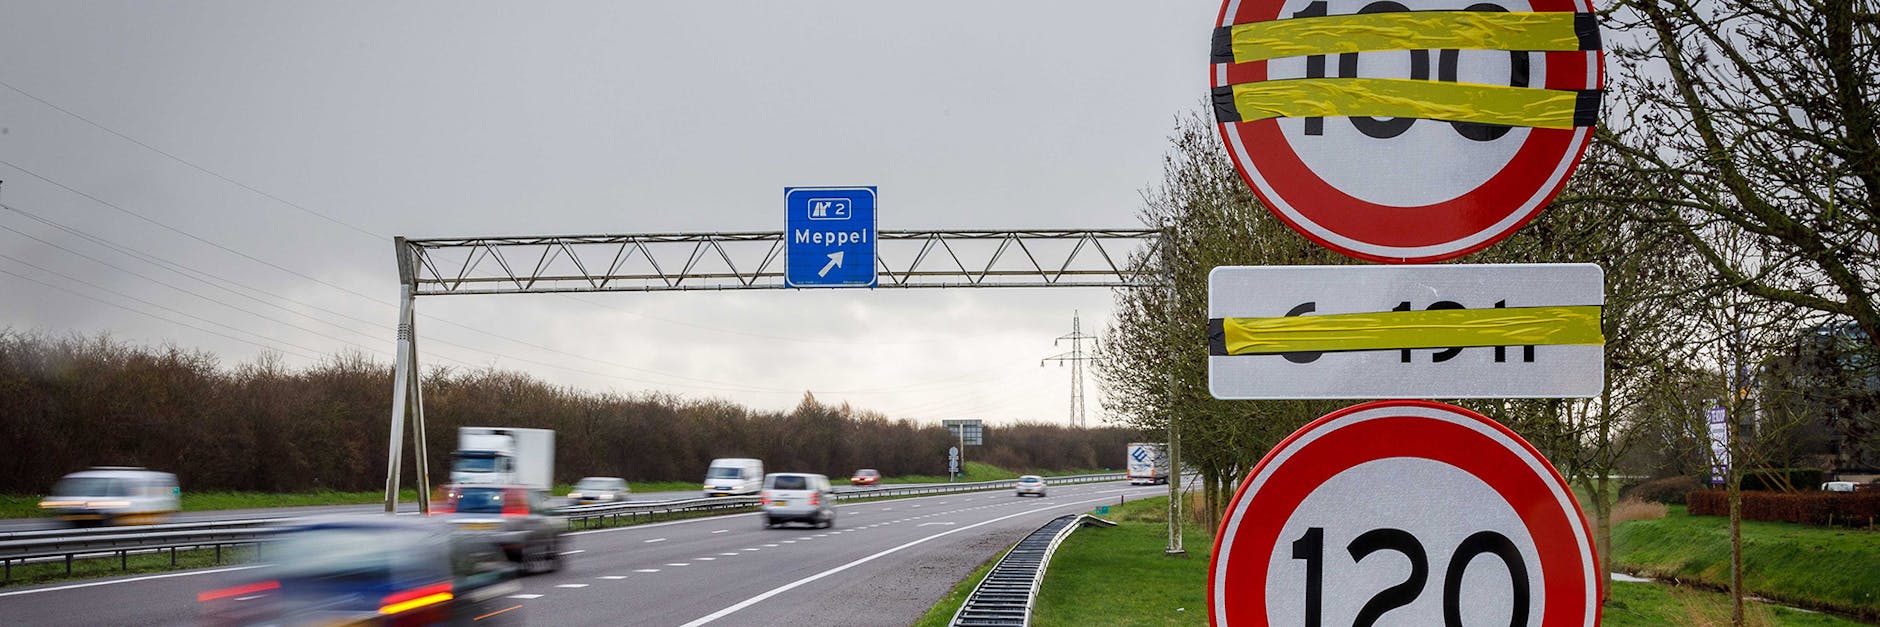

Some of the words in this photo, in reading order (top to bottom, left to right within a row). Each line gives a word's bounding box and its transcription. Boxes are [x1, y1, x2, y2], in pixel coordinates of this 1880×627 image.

[835, 203, 845, 215] 2
[795, 228, 867, 246] Meppel
[1292, 527, 1530, 627] 120
